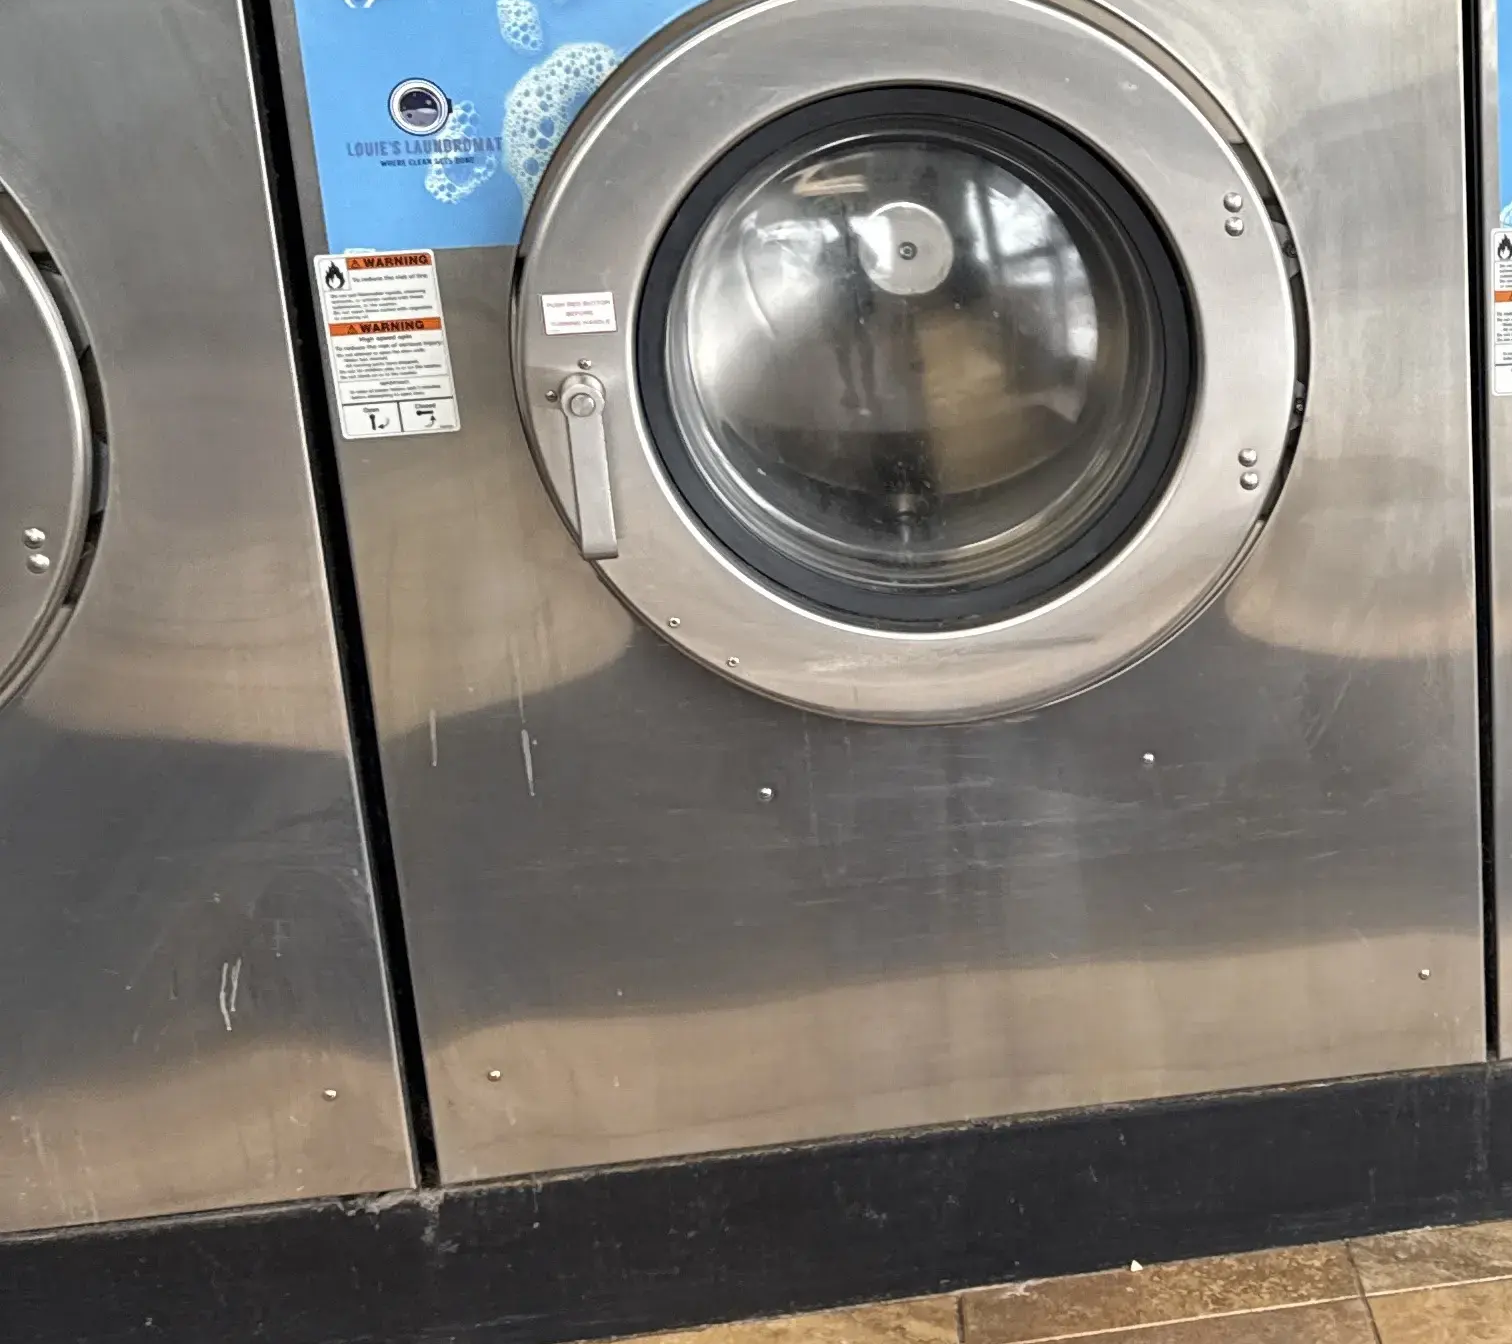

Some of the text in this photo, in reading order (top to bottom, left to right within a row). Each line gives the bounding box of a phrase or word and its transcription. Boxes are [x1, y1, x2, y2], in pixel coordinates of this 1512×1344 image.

[346, 136, 502, 157] LOUIE'S LAUNDROMAT
[363, 254, 429, 268] WARNING
[359, 320, 425, 333] WARNING
